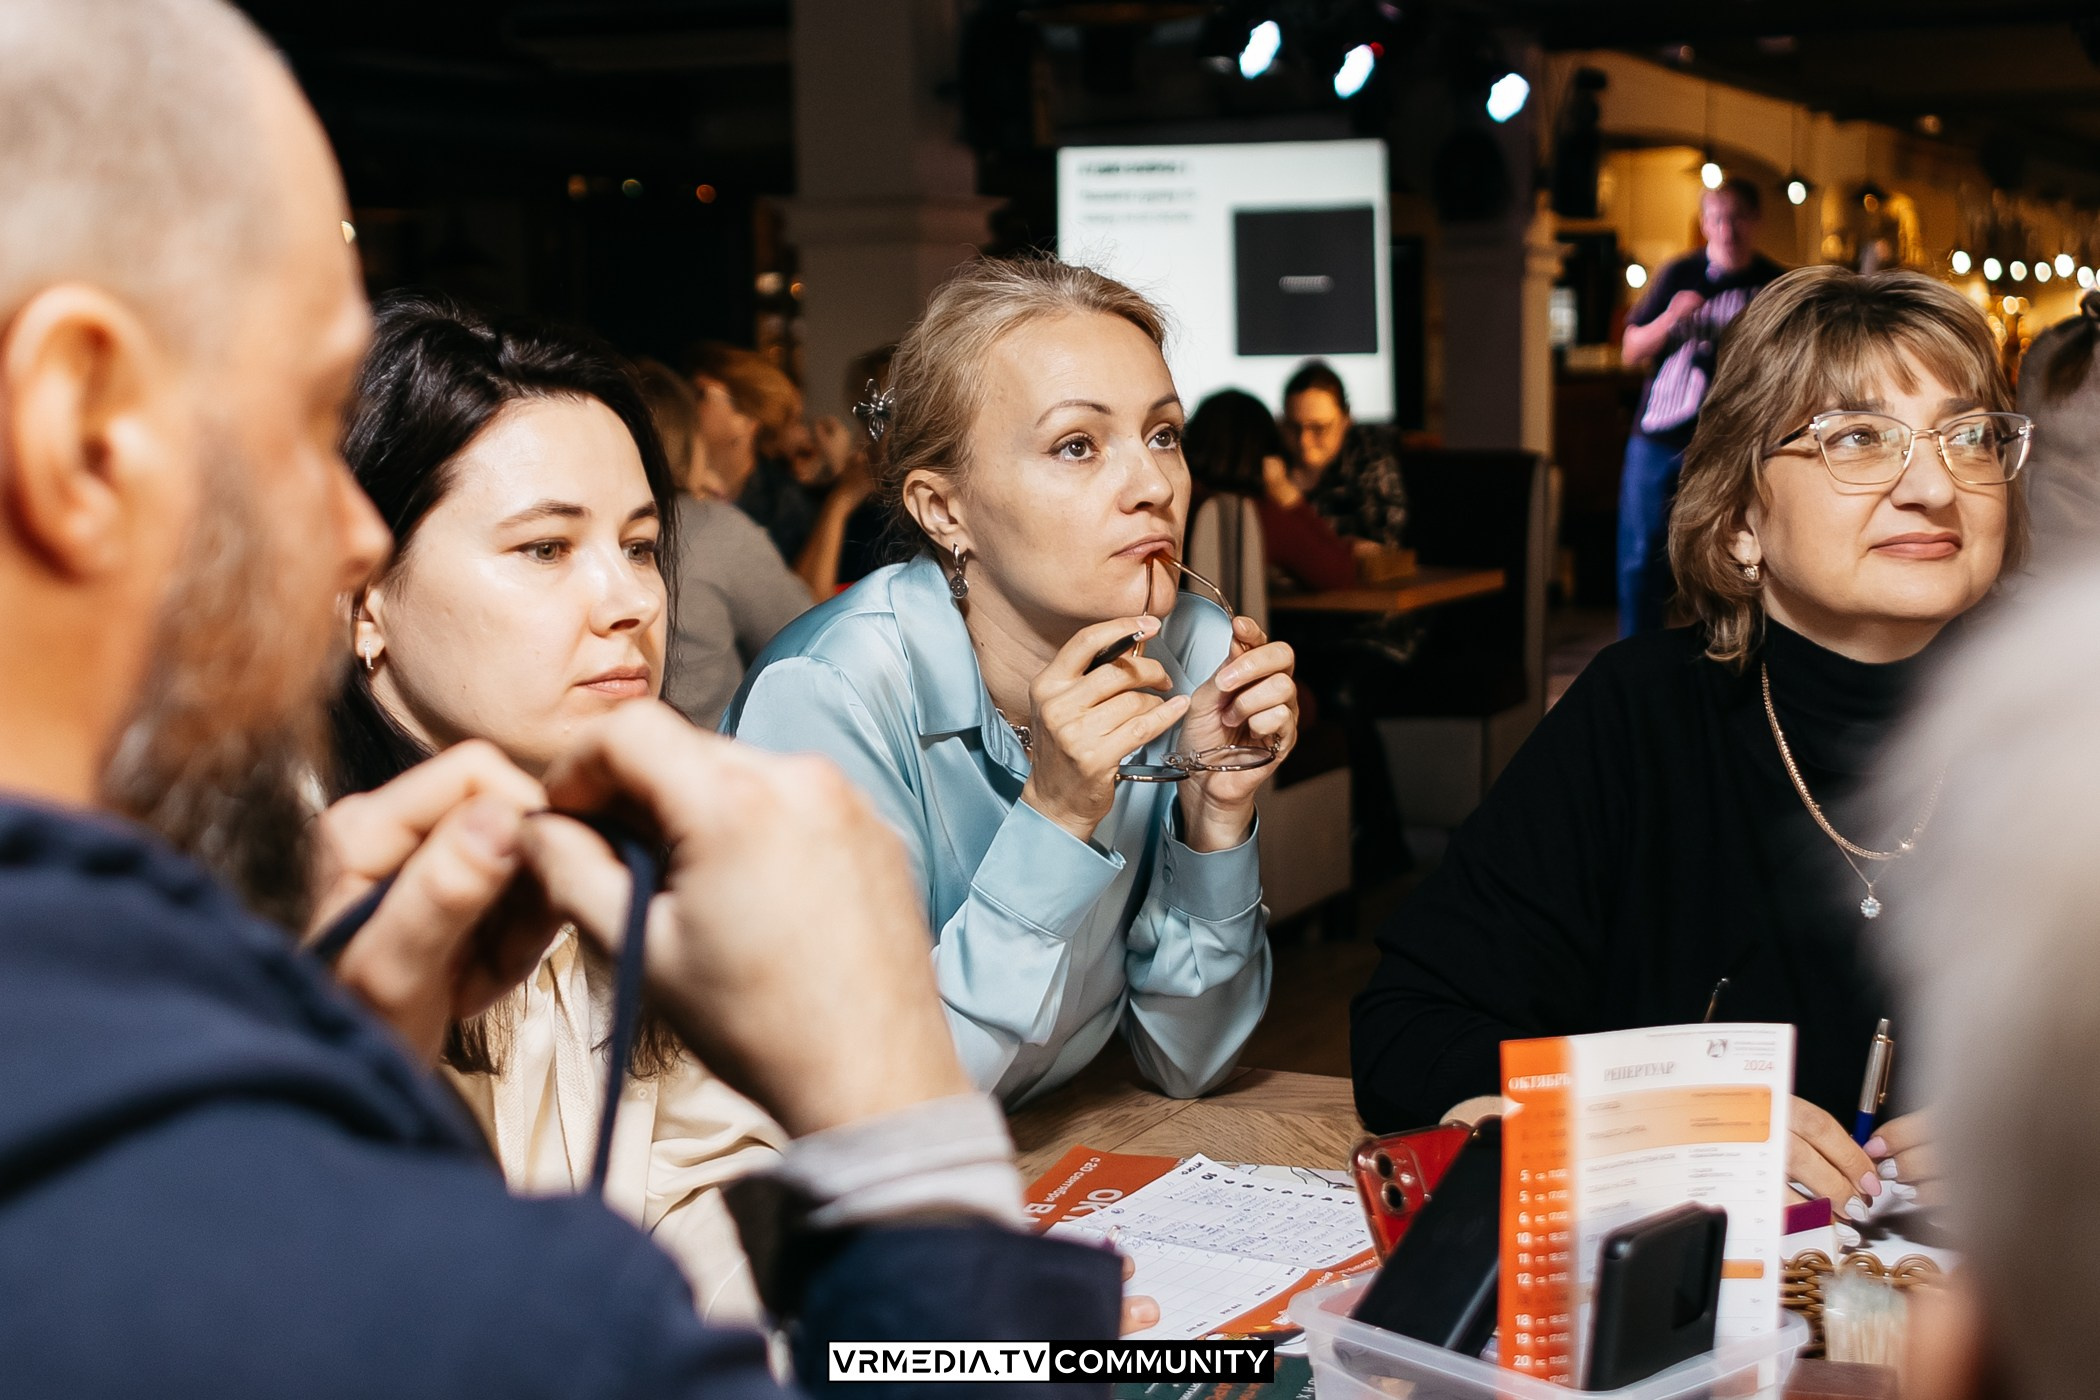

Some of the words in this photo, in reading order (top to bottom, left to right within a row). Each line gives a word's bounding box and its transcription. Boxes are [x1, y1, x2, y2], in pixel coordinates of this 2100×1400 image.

[1603, 1061, 1676, 1082] РЕПЕРТУАР
[1744, 1060, 1774, 1071] 2024
[1508, 1073, 1573, 1090] ОКТЯБРЬ
[1520, 1169, 1530, 1182] 5
[1519, 1190, 1529, 1204] 5
[1519, 1212, 1529, 1225] 6
[1516, 1232, 1531, 1245] 10
[1517, 1253, 1530, 1265] 11
[1516, 1272, 1531, 1285] 12
[1515, 1314, 1531, 1326] 18
[1515, 1333, 1531, 1345] 19
[1513, 1355, 1531, 1367] 20
